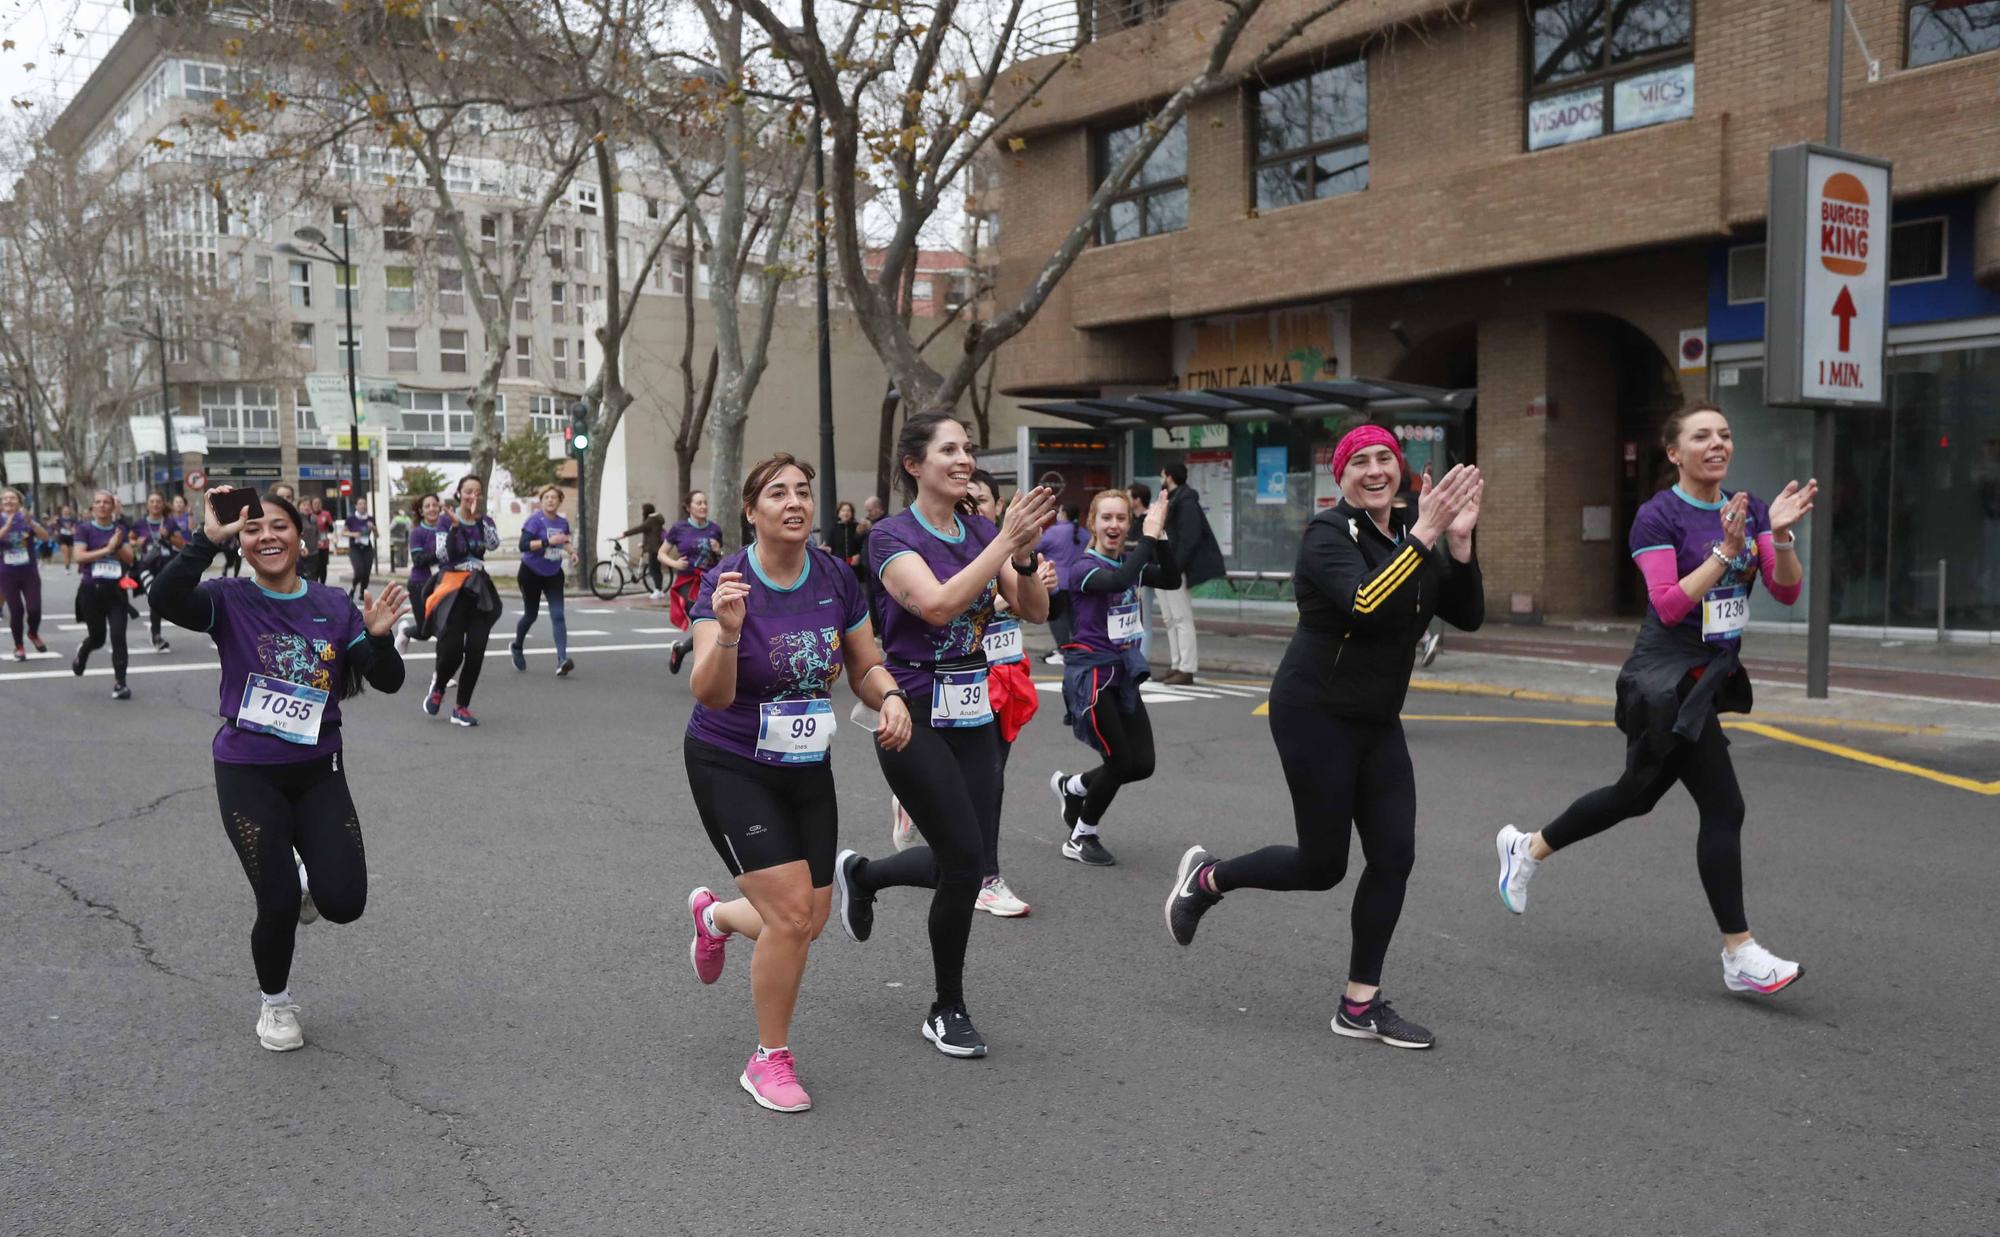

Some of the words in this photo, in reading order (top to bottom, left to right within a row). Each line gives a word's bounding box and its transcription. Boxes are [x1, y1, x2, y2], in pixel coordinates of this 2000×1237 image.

[1531, 101, 1603, 133] VISADOS
[1821, 201, 1869, 229] BURGER
[1821, 223, 1869, 258] KING
[1819, 360, 1825, 386] 1
[1829, 361, 1864, 389] MIN.
[1715, 599, 1744, 620] 1236
[985, 631, 1016, 651] 1237
[261, 693, 313, 721] 1055
[960, 685, 981, 706] 39
[790, 717, 817, 739] 99
